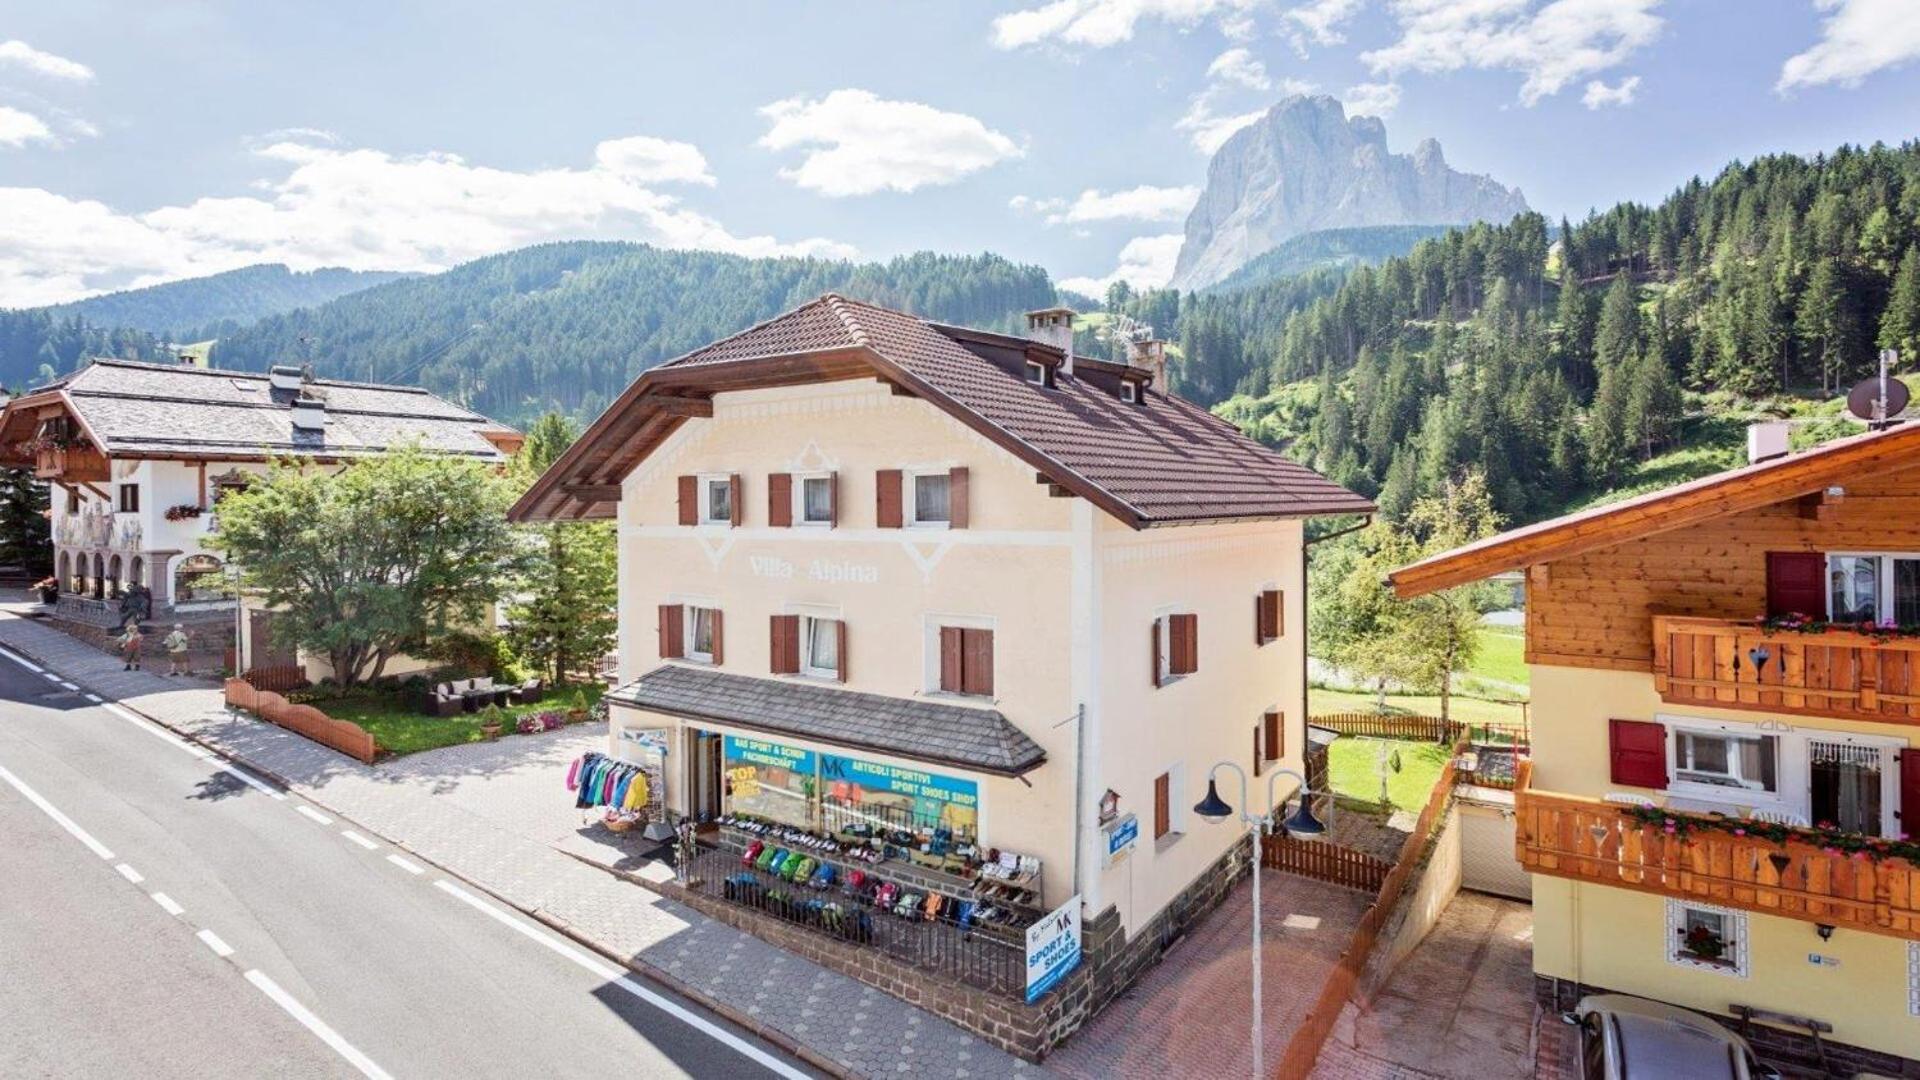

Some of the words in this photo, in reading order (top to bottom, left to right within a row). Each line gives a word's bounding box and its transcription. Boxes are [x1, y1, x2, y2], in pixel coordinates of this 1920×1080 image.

[749, 556, 793, 578] Villa
[808, 558, 880, 584] Alpina
[749, 741, 772, 753] SPORT
[726, 766, 757, 781] TOP
[822, 756, 845, 778] MK
[852, 760, 890, 777] ARTICOLI
[890, 767, 931, 785] SPORTIVI
[891, 779, 918, 794] SPORT
[921, 785, 949, 800] SHOES
[952, 791, 976, 806] SHOP
[1029, 934, 1063, 968] SPORT
[1064, 930, 1072, 942] &
[1044, 938, 1077, 971] SHOES
